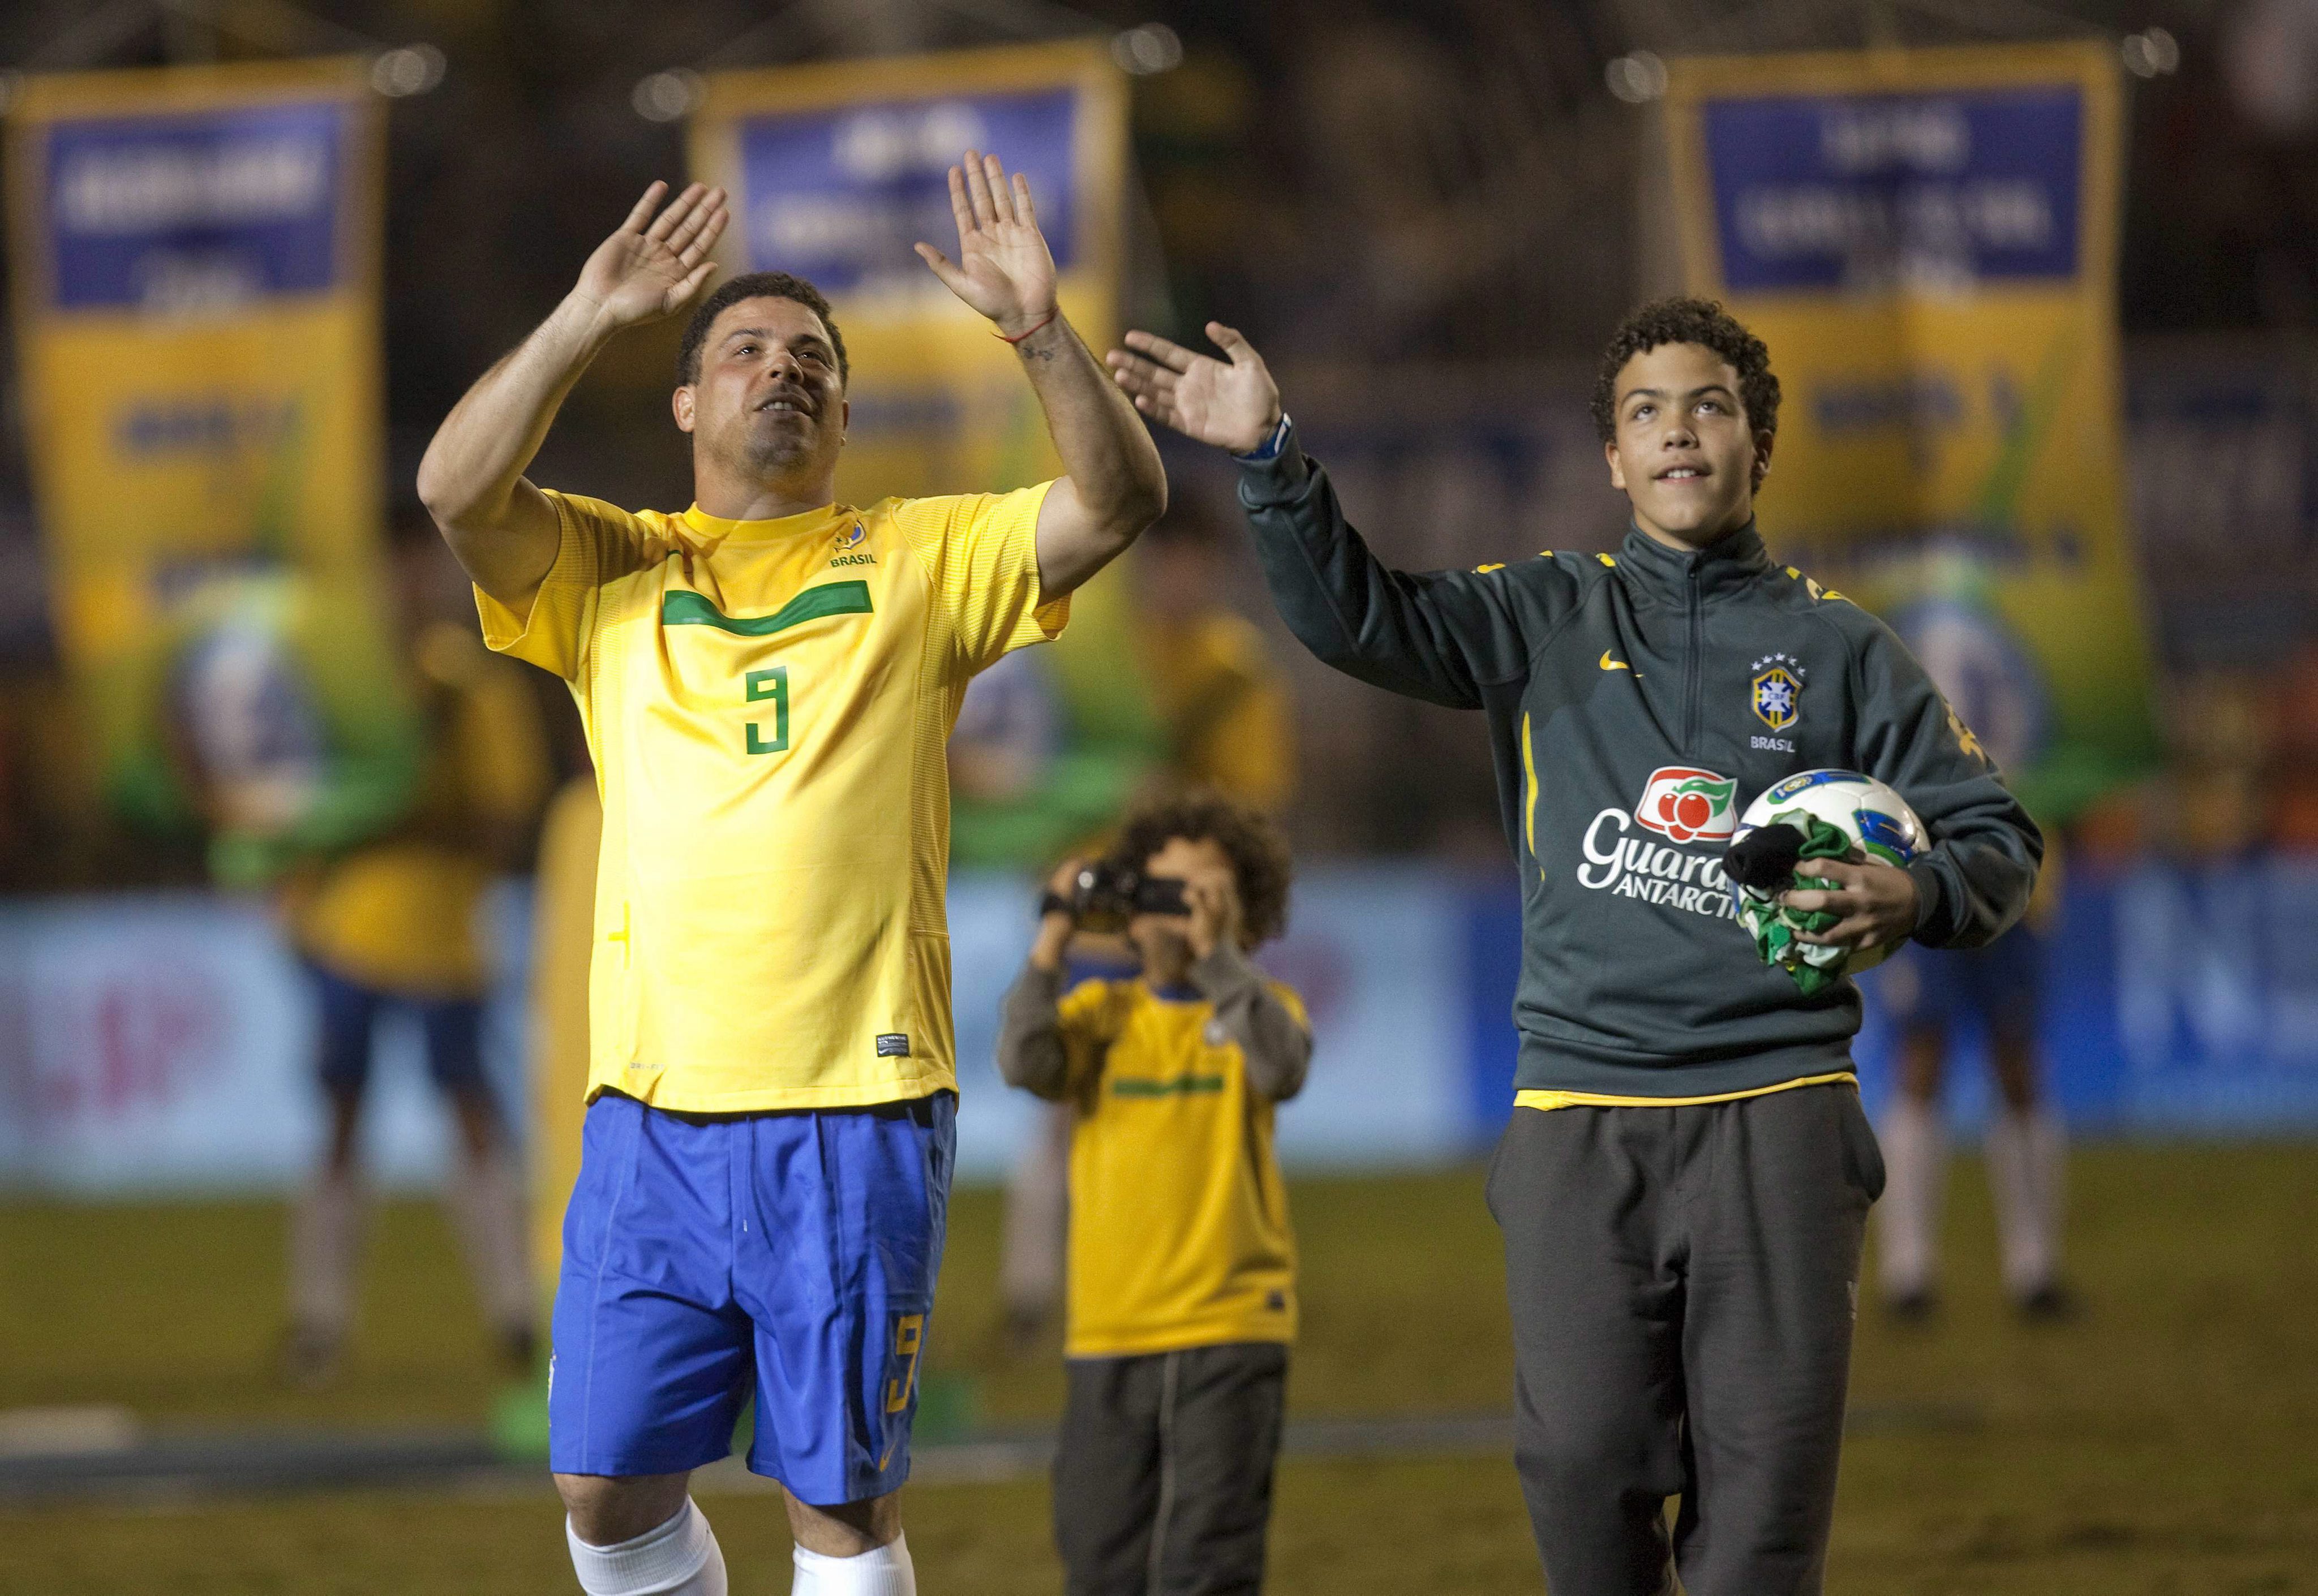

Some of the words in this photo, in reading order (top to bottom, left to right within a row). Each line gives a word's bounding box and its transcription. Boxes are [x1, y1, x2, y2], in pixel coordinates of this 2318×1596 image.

[830, 554, 877, 568] BRASIL
[746, 665, 788, 755] 9
[1750, 735, 1795, 753] BRASIL
[886, 1314, 924, 1413] 9
